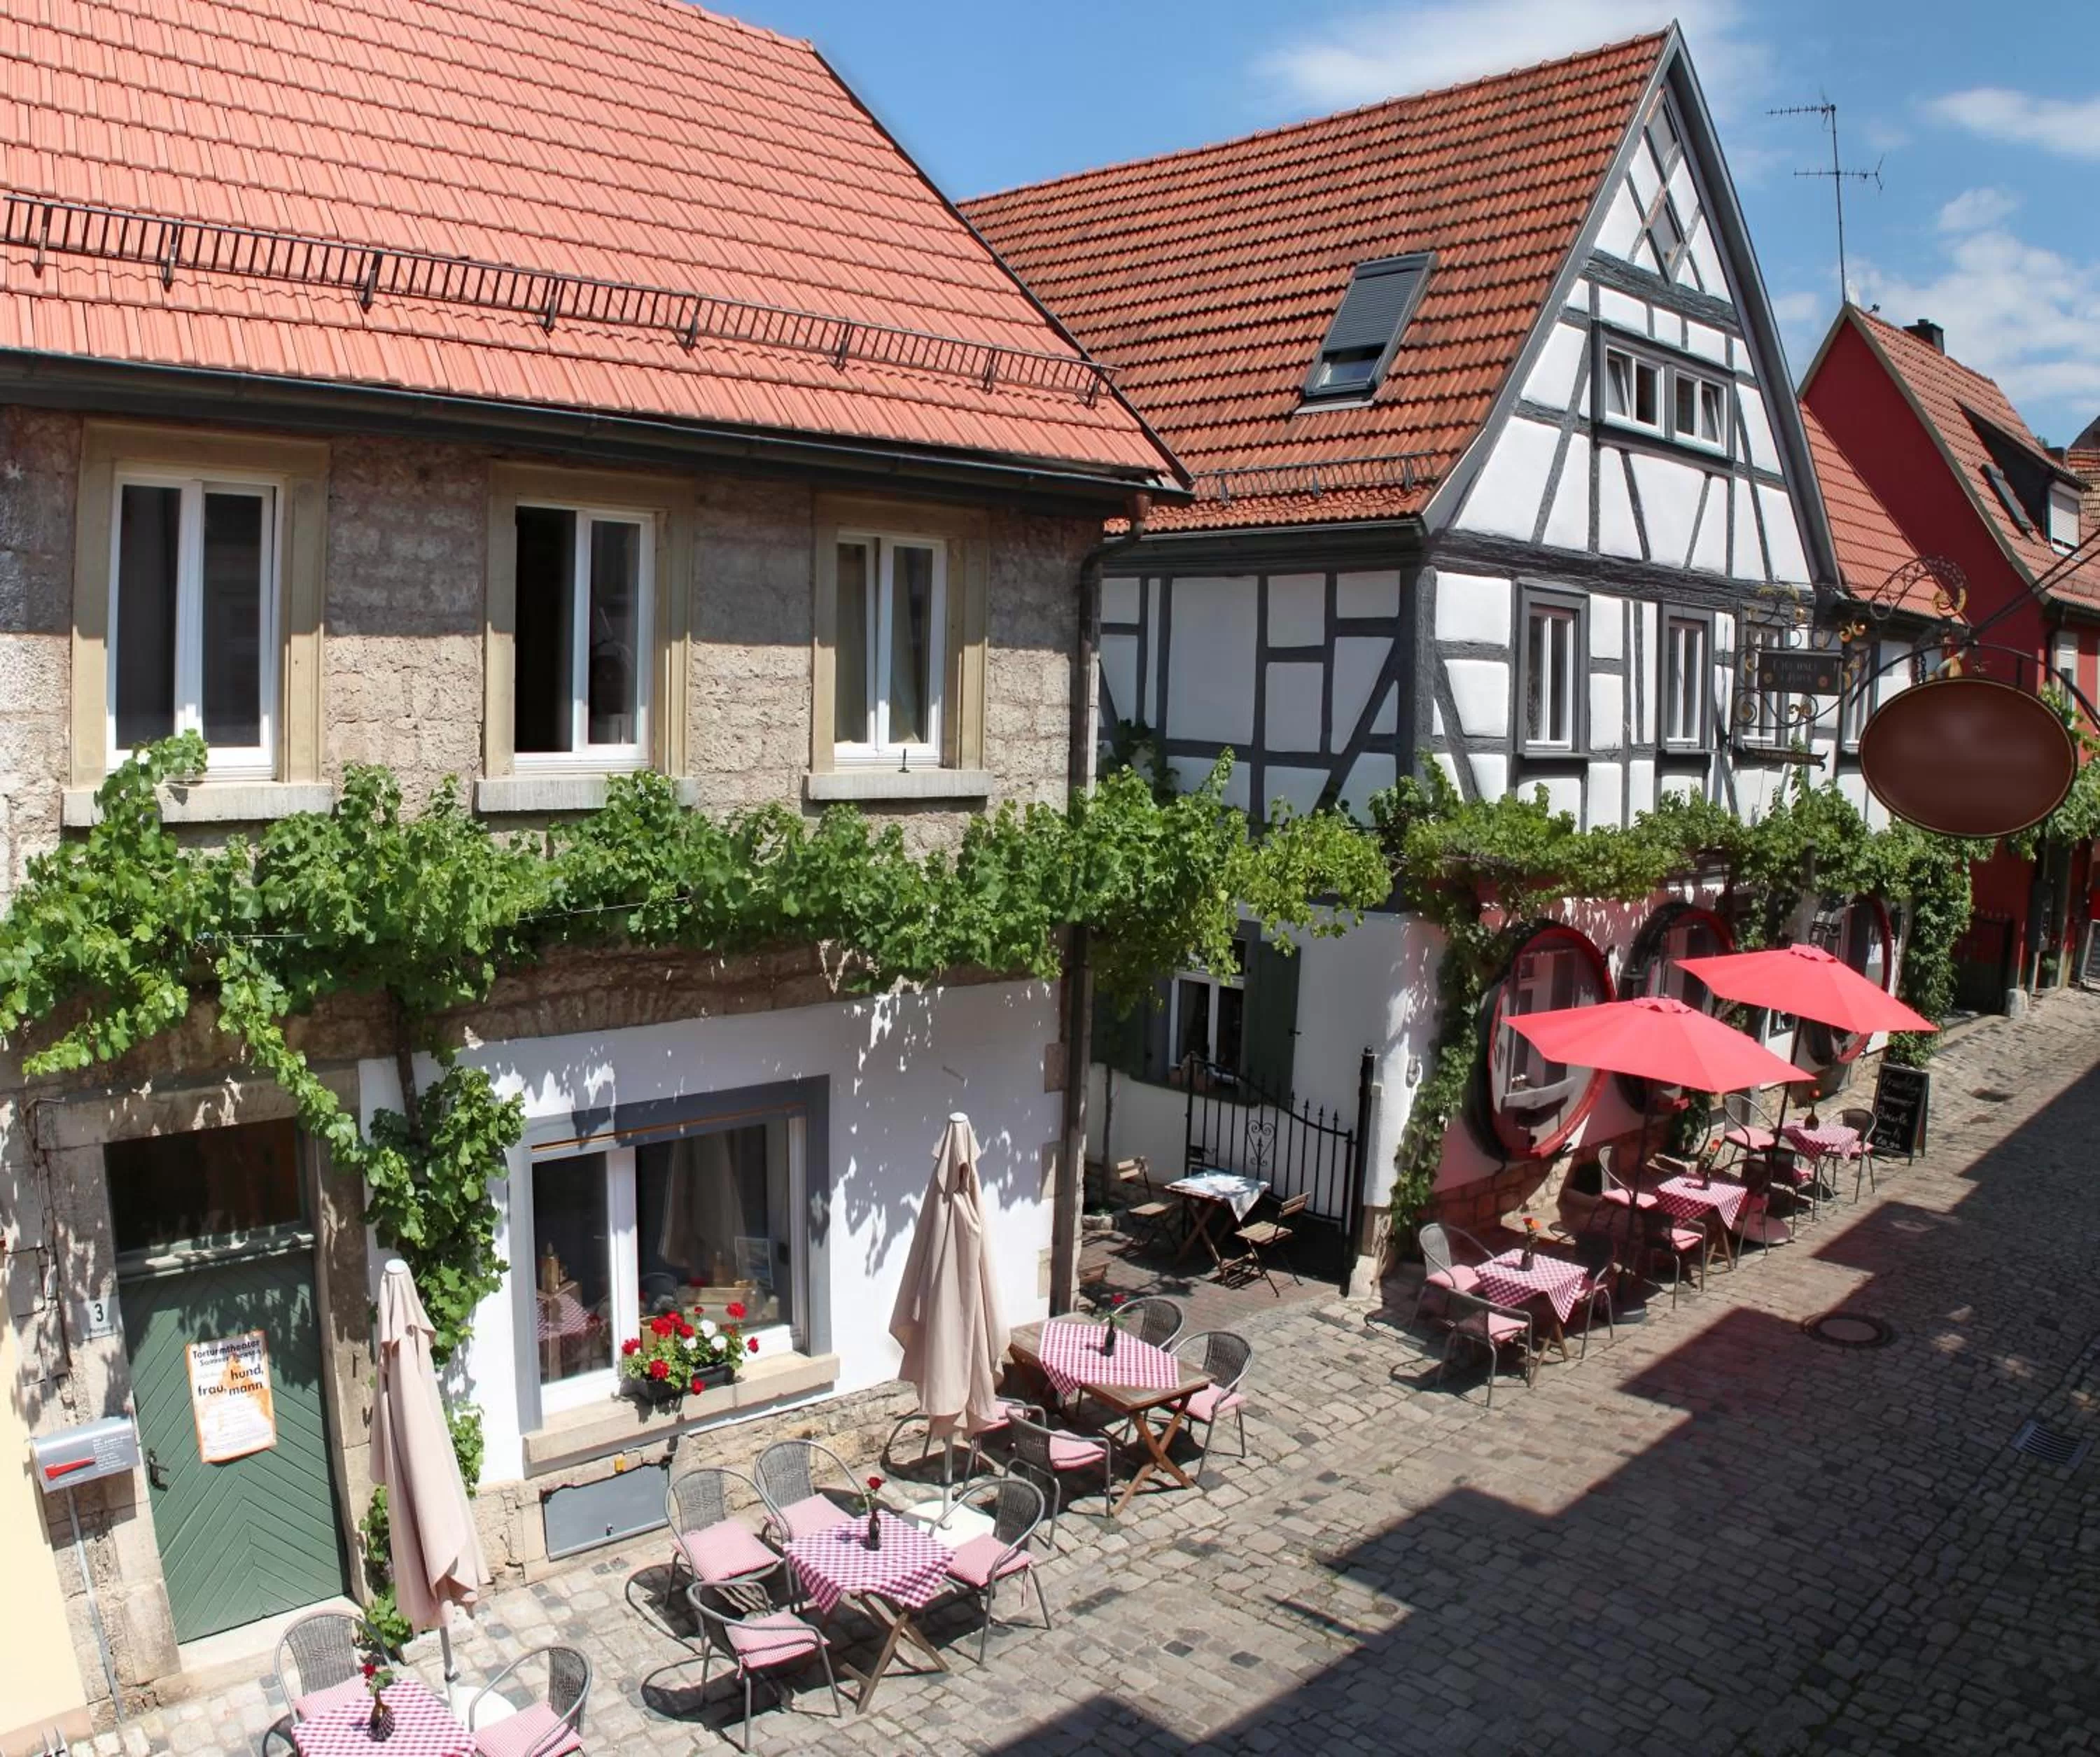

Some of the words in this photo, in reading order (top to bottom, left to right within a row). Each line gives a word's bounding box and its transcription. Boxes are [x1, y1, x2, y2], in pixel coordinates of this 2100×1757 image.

[94, 1303, 104, 1322] 3
[192, 1340, 260, 1359] Torturmtheater
[230, 1364, 263, 1380] hund,
[198, 1385, 227, 1396] frau,
[229, 1382, 262, 1396] mann
